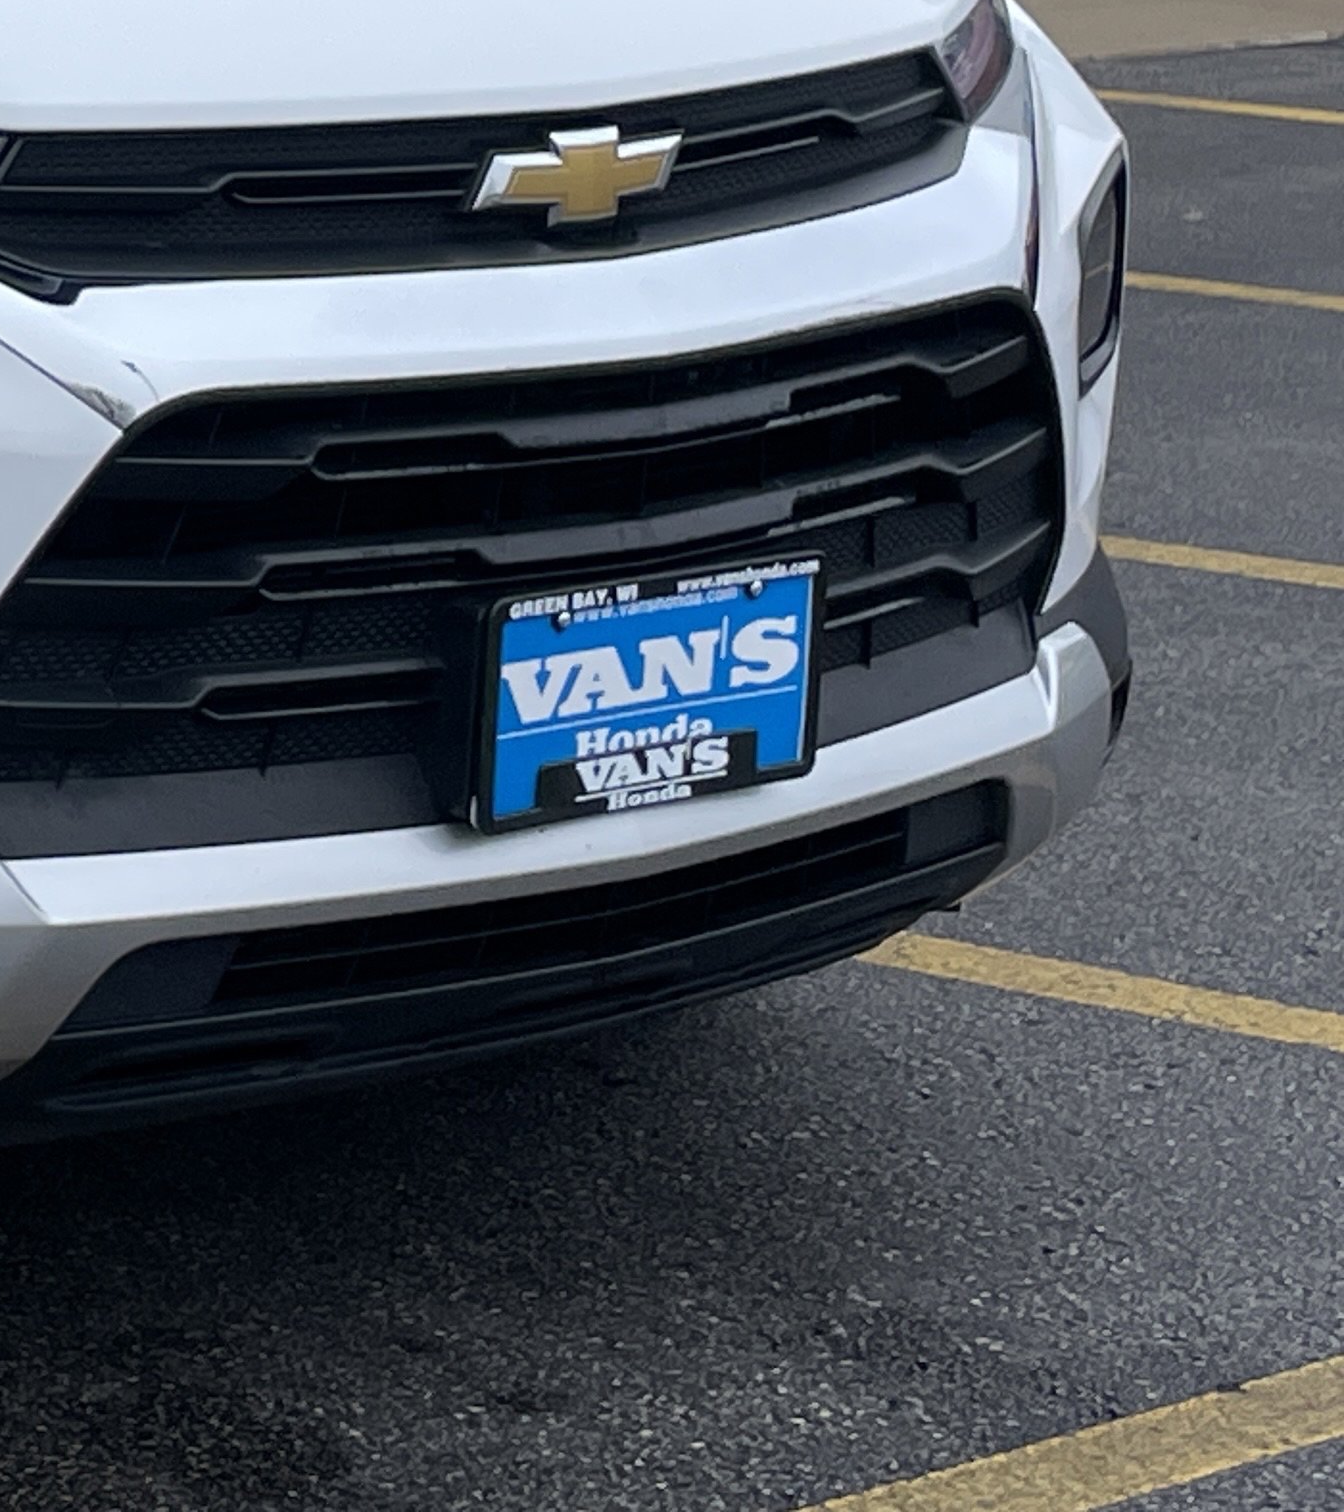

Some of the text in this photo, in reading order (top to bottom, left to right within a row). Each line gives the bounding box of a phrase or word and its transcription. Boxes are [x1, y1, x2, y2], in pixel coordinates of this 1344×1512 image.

[677, 559, 820, 594] www.vanshonda.com
[509, 583, 638, 620] GREEN BAY, WI
[501, 615, 800, 724] VAN'S
[575, 713, 713, 758] Honda
[576, 736, 729, 792] VAN'S
[608, 783, 692, 810] Honda
